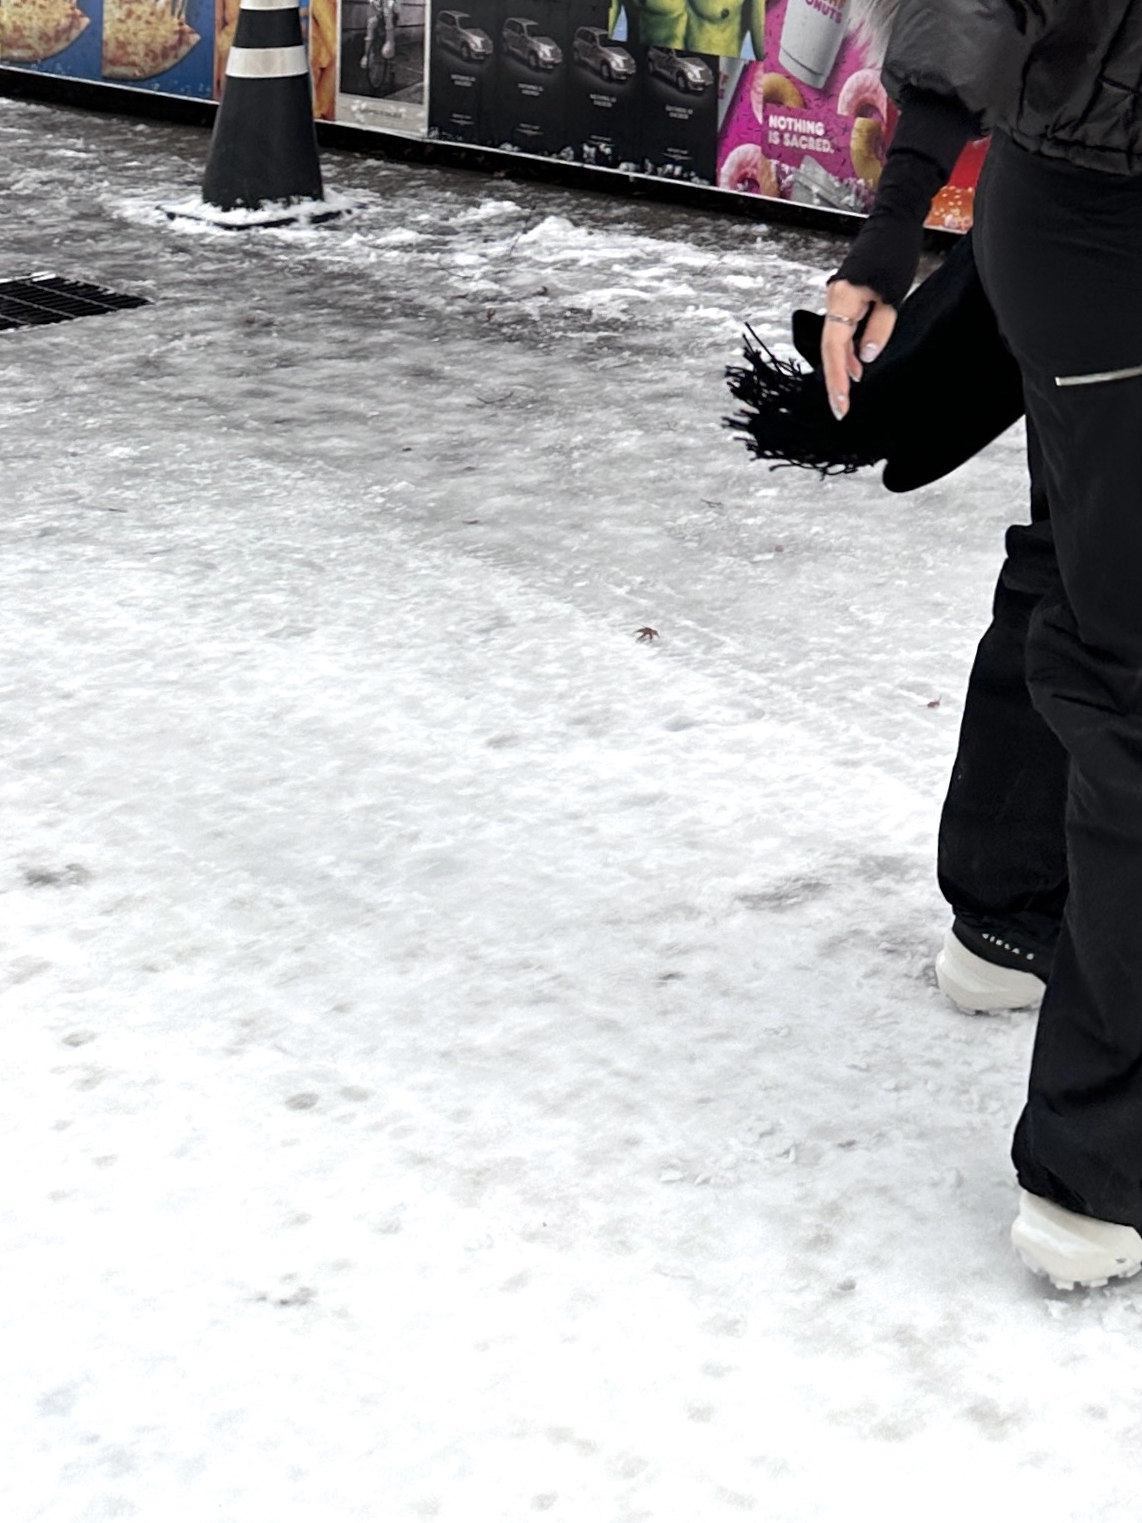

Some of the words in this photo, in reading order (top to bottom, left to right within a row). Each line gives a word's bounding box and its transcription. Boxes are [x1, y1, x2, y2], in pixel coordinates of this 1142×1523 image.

[768, 113, 826, 137] NOTHING
[768, 131, 781, 147] IS
[784, 134, 835, 155] SACRED.
